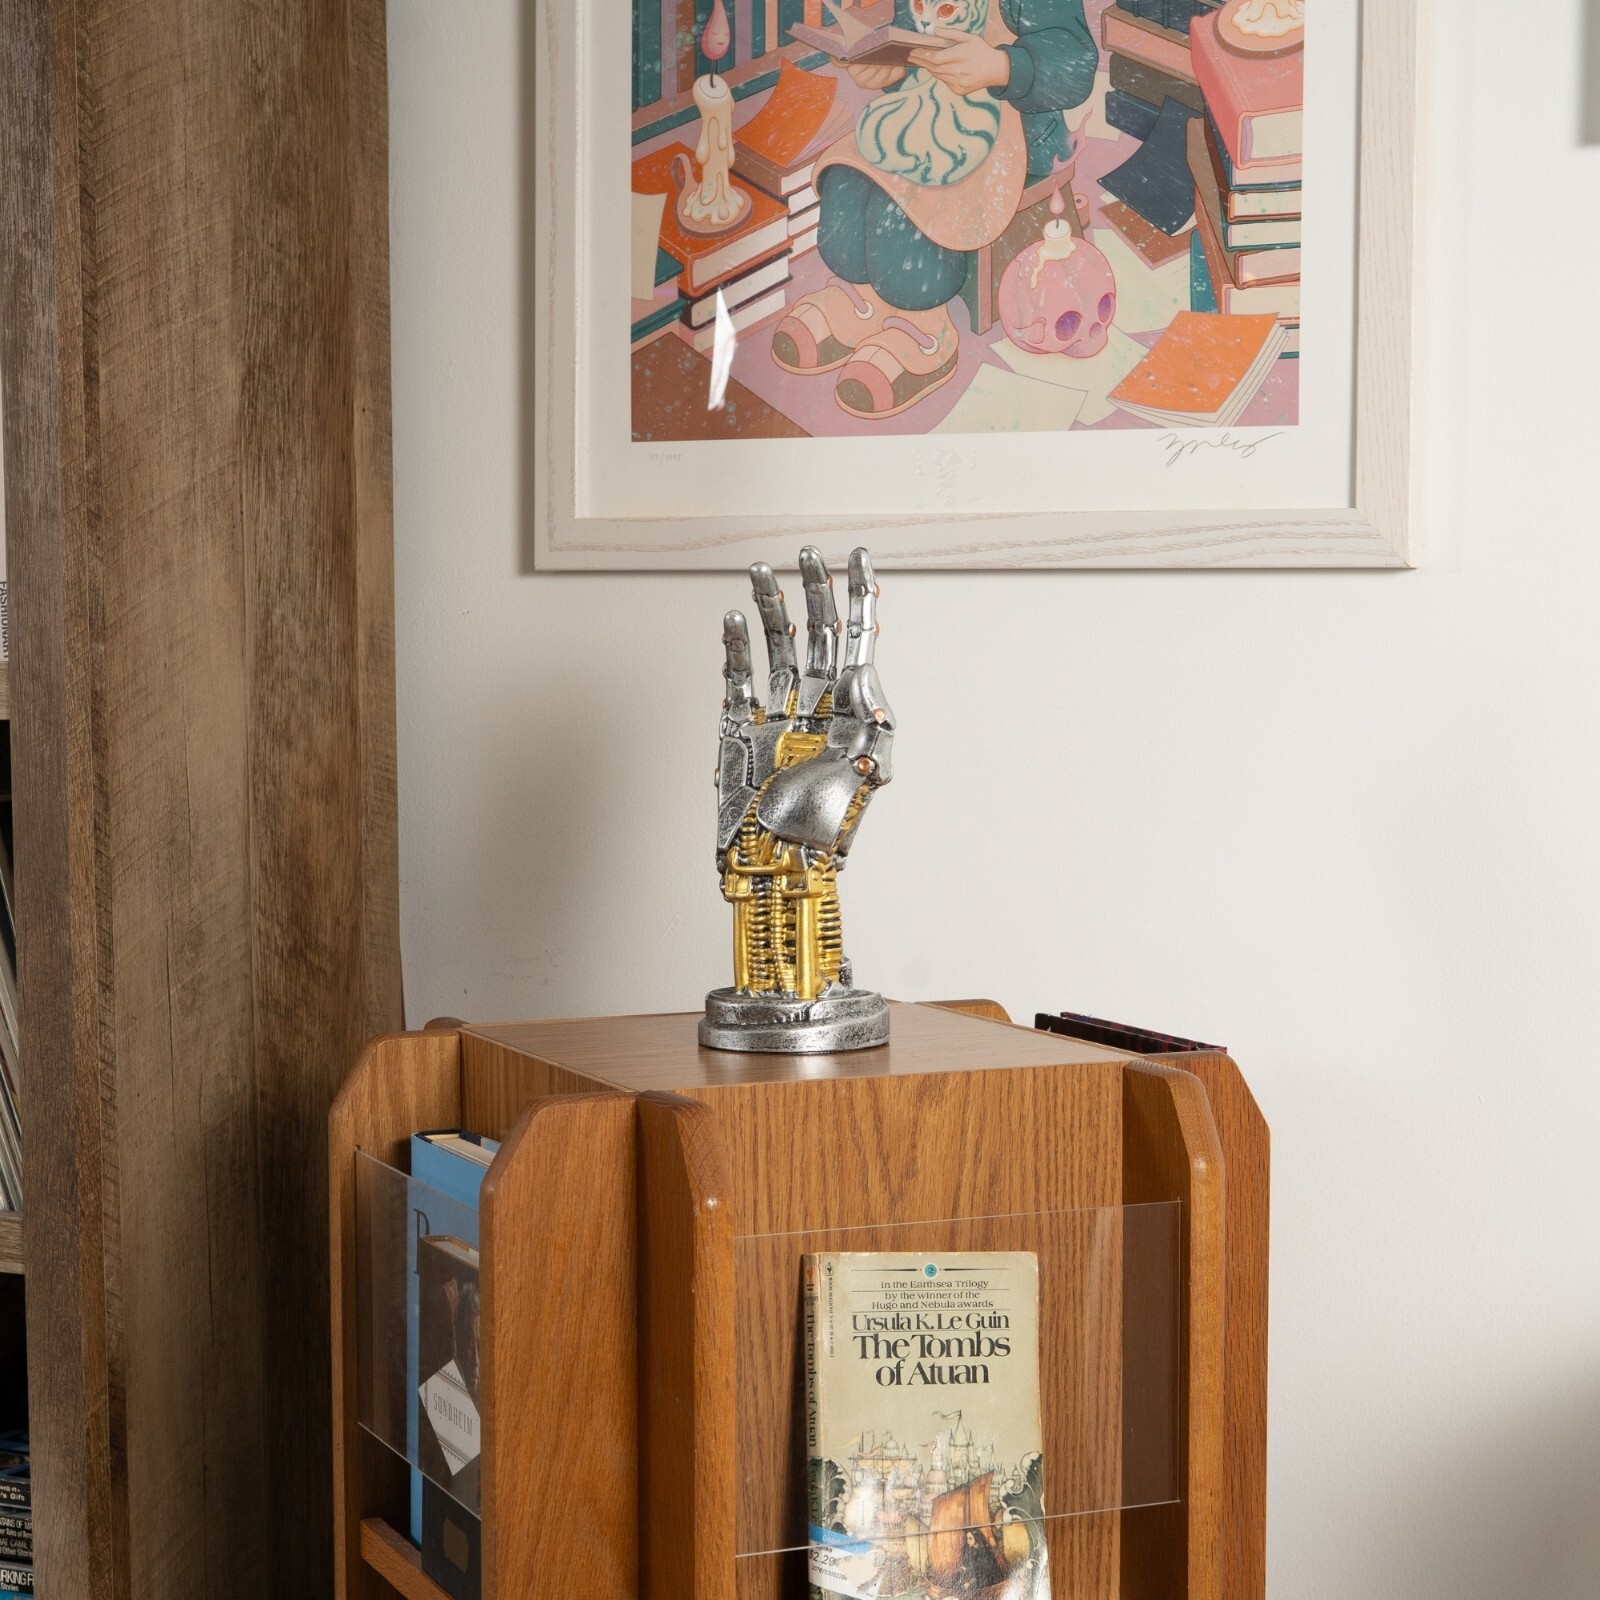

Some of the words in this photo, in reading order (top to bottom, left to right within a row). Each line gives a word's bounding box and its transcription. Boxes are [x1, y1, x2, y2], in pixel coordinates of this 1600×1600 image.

[886, 1292, 898, 1301] by
[953, 1290, 964, 1299] of
[893, 1280, 908, 1288] the
[910, 1280, 952, 1288] Earthsea
[954, 1280, 989, 1289] Trilogy
[872, 1302, 898, 1310] Hugo
[807, 1311, 815, 1338] The
[852, 1313, 912, 1331] Ursula
[916, 1314, 934, 1330] K.
[937, 1313, 962, 1330] Le
[966, 1311, 1010, 1329] Guin
[852, 1333, 911, 1360] The
[911, 1331, 1011, 1358] Tombs
[807, 1340, 817, 1388] Tombs
[876, 1358, 906, 1386] of
[907, 1361, 990, 1386] Atuan
[808, 1391, 817, 1406] of
[433, 1392, 473, 1437] SONDHEIM
[808, 1407, 817, 1448] Atuan
